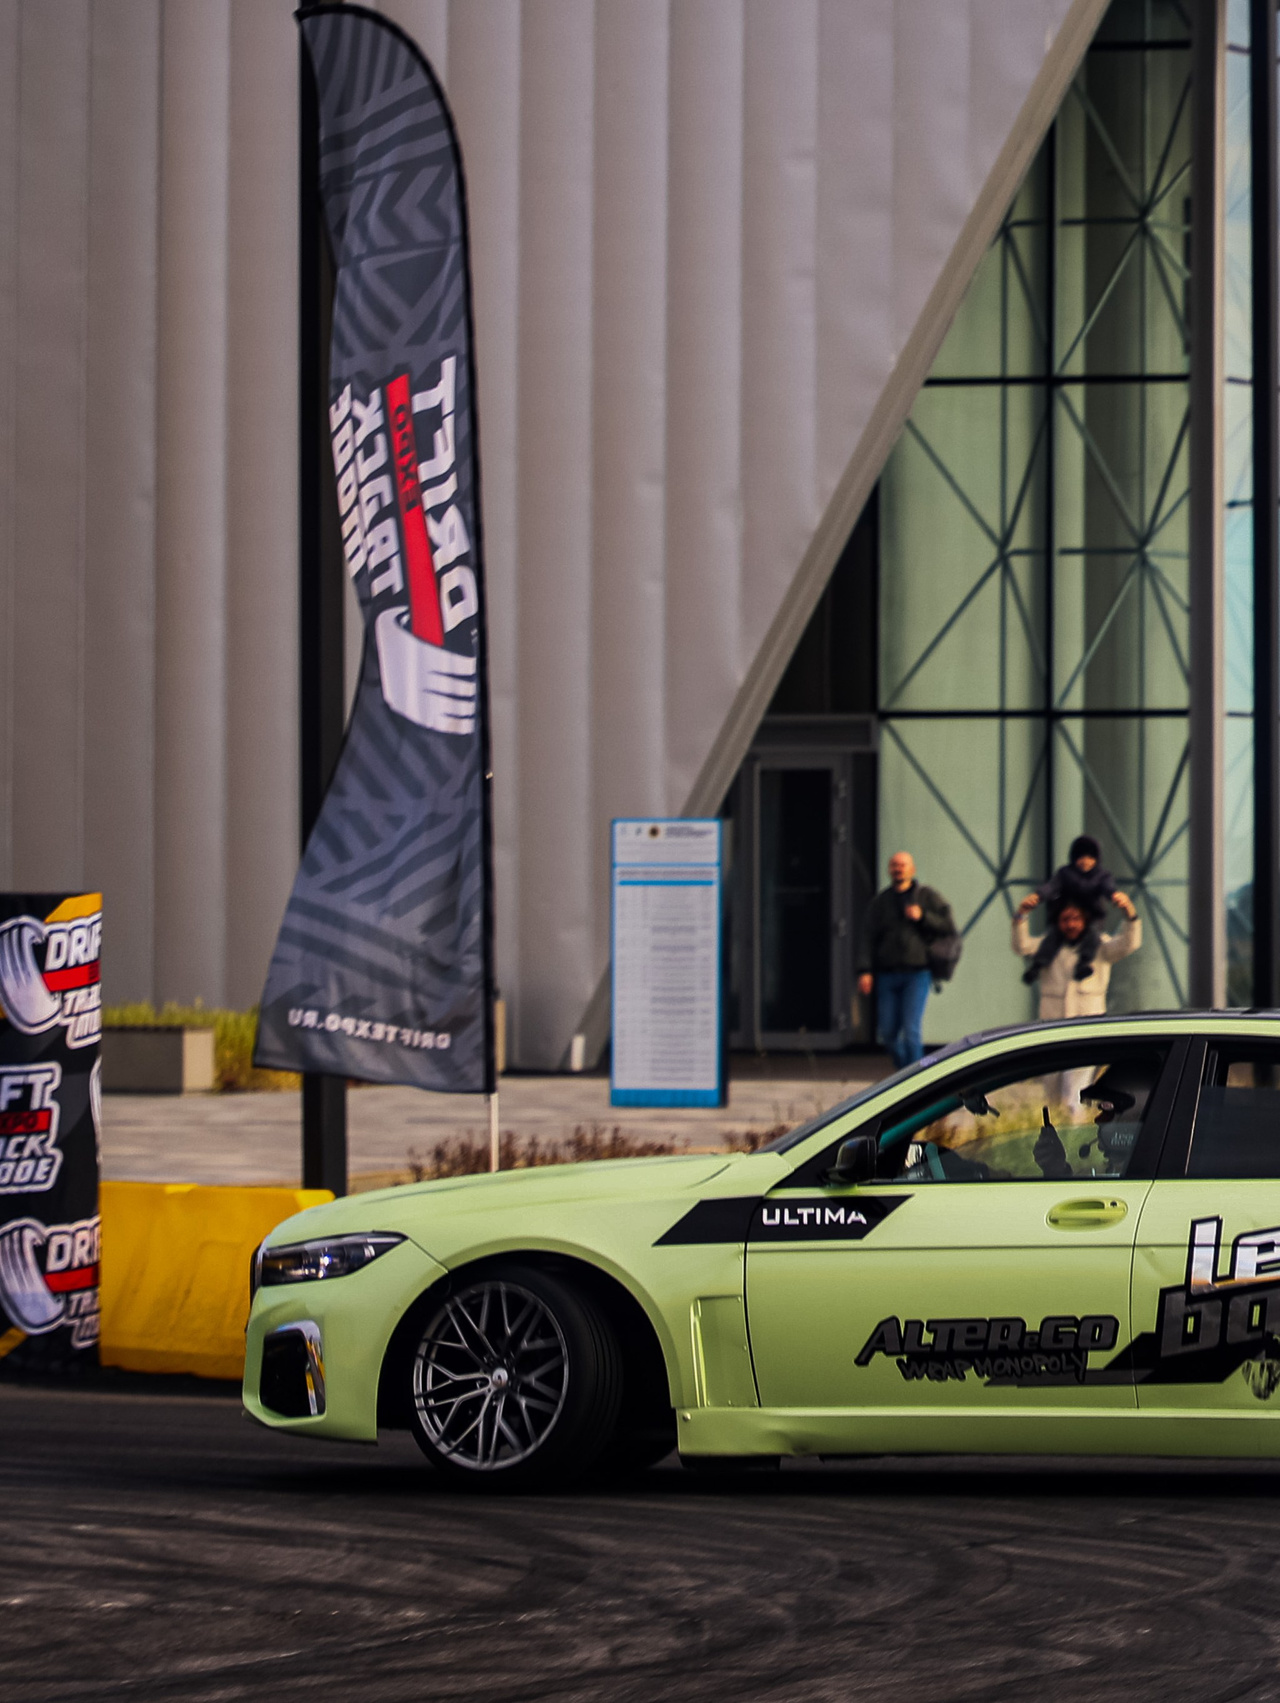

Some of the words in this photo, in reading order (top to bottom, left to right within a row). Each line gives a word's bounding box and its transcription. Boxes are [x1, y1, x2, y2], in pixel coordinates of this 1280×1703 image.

[762, 1207, 868, 1226] ULTIMA
[896, 1357, 974, 1382] WRAP
[974, 1350, 1088, 1384] MONOPOLY
